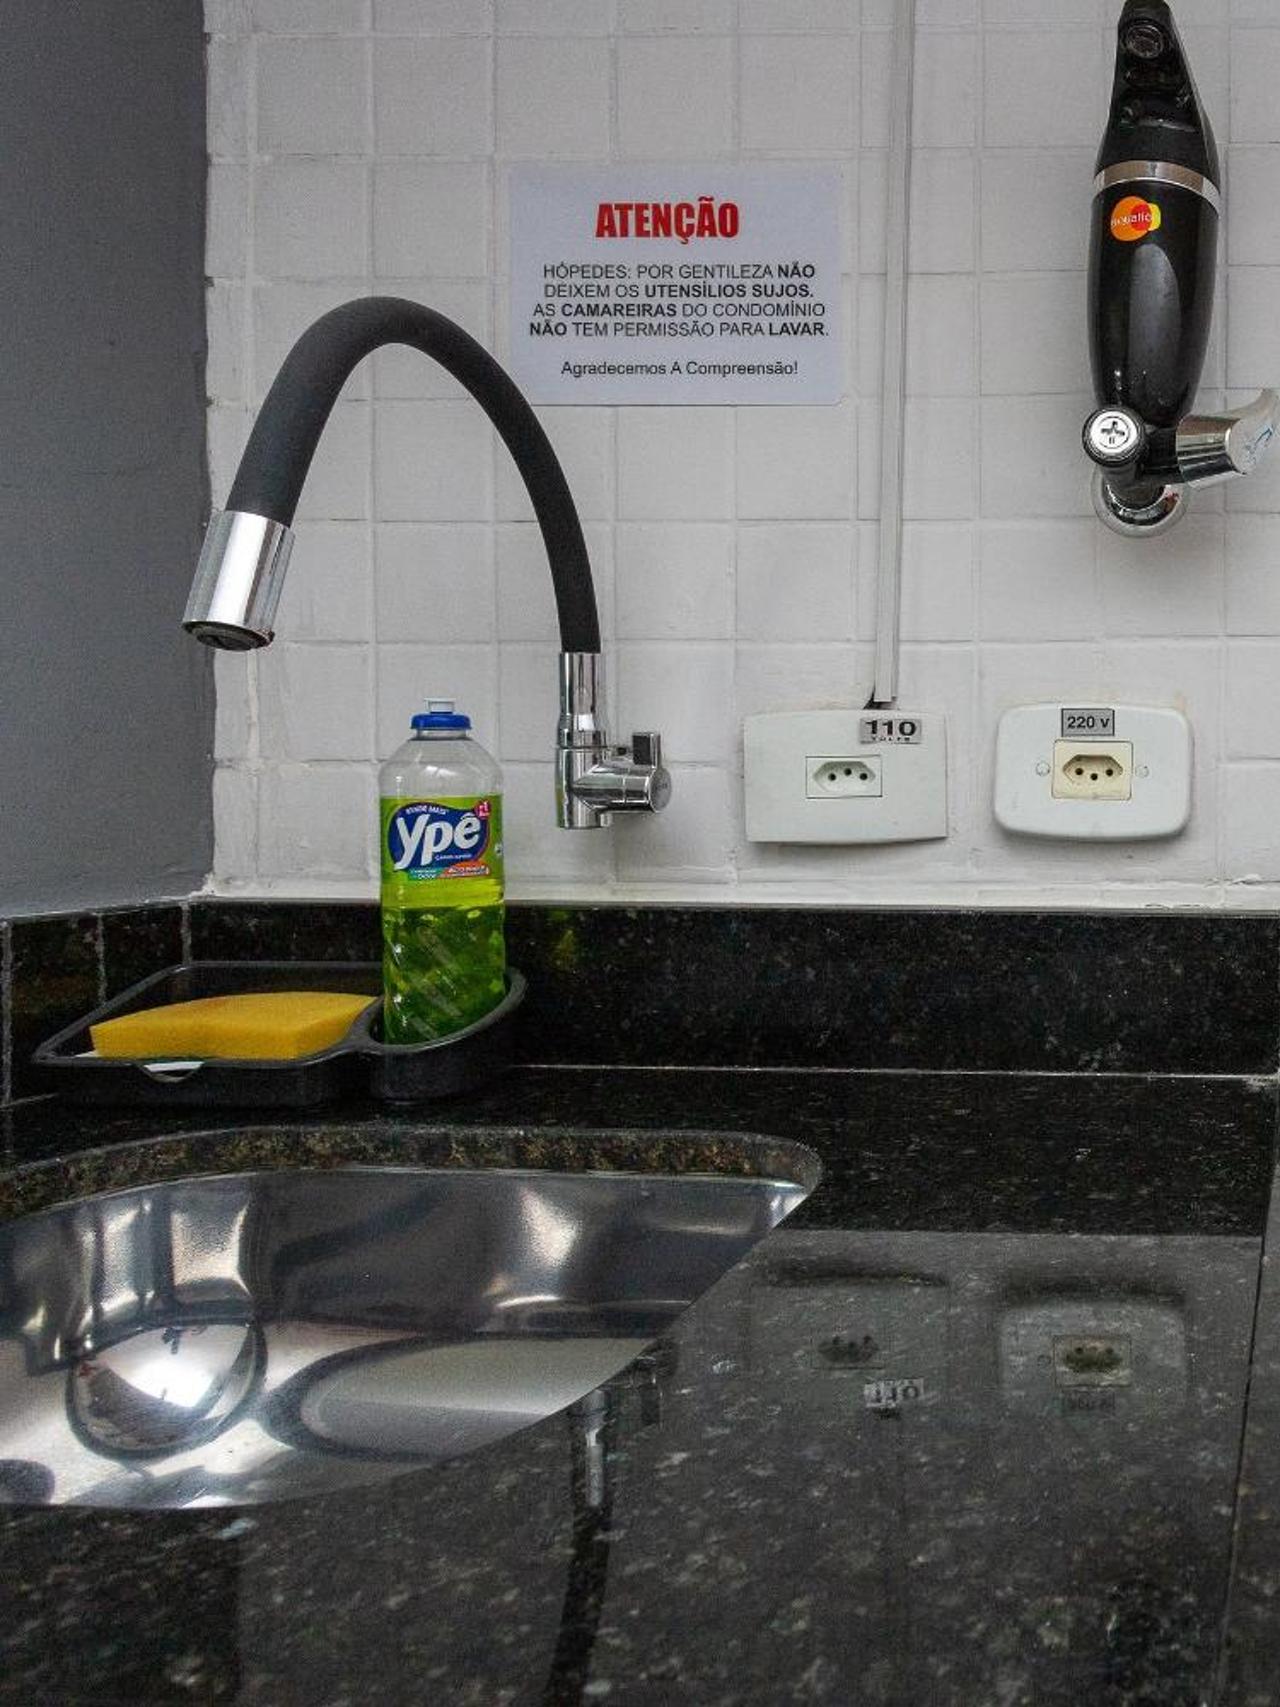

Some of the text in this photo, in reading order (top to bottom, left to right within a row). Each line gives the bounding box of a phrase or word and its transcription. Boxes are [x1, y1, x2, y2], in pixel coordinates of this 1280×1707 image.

[595, 196, 740, 244] ATENÇÃO
[543, 262, 815, 280] HÓPEDES: POR GENTILEZA NÃO
[544, 281, 814, 299] DEIXEM OS UTENSÍLIOS SUJOS.
[533, 301, 826, 317] AS CAMAREIRAS DO CONDOMÍNIO
[529, 320, 829, 337] NÃO TEM PERMISSÃO PARA LAVAR.
[560, 360, 798, 378] Agradecemos A Compreensão!
[865, 720, 917, 736] 110
[1067, 716, 1095, 729] 220
